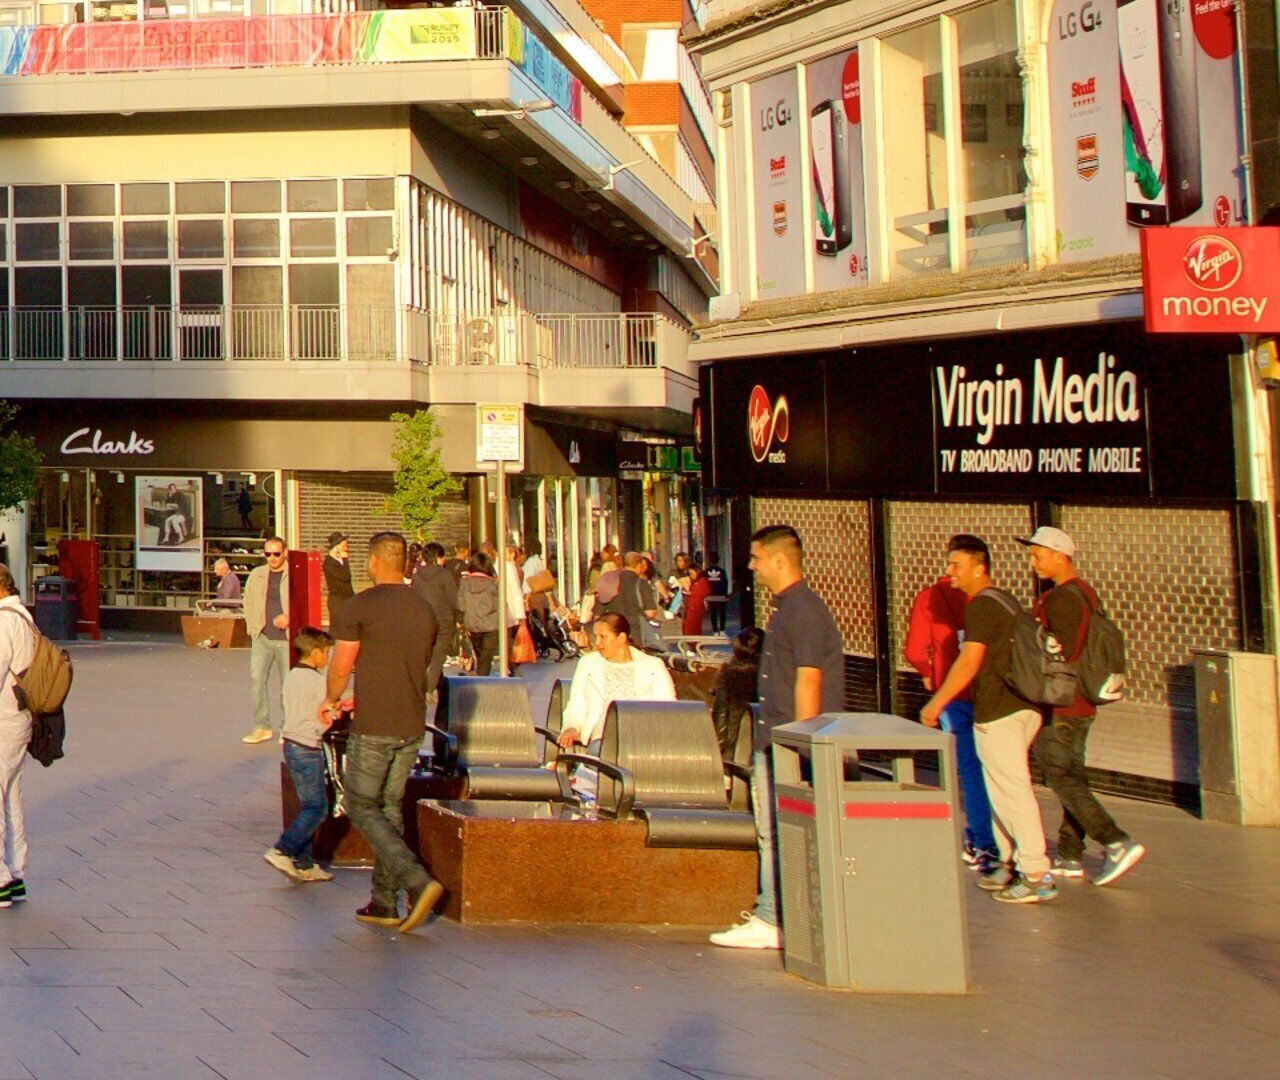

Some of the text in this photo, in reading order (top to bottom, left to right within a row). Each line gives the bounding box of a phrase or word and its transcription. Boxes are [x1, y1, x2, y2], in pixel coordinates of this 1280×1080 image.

[1058, 0, 1103, 41] LG G4
[1195, 2, 1209, 15] Feel
[1209, 0, 1221, 11] the
[431, 36, 460, 44] 2015
[1071, 77, 1096, 98] Stuff
[760, 98, 792, 132] LG G4
[1184, 242, 1236, 283] Virgin
[1163, 296, 1268, 323] money
[937, 351, 1141, 445] Virgin Media
[751, 397, 771, 448] Virgin
[60, 427, 155, 455] Clarks
[769, 448, 787, 464] media
[941, 446, 1143, 474] TV BROADBAND PHONE MOBILE
